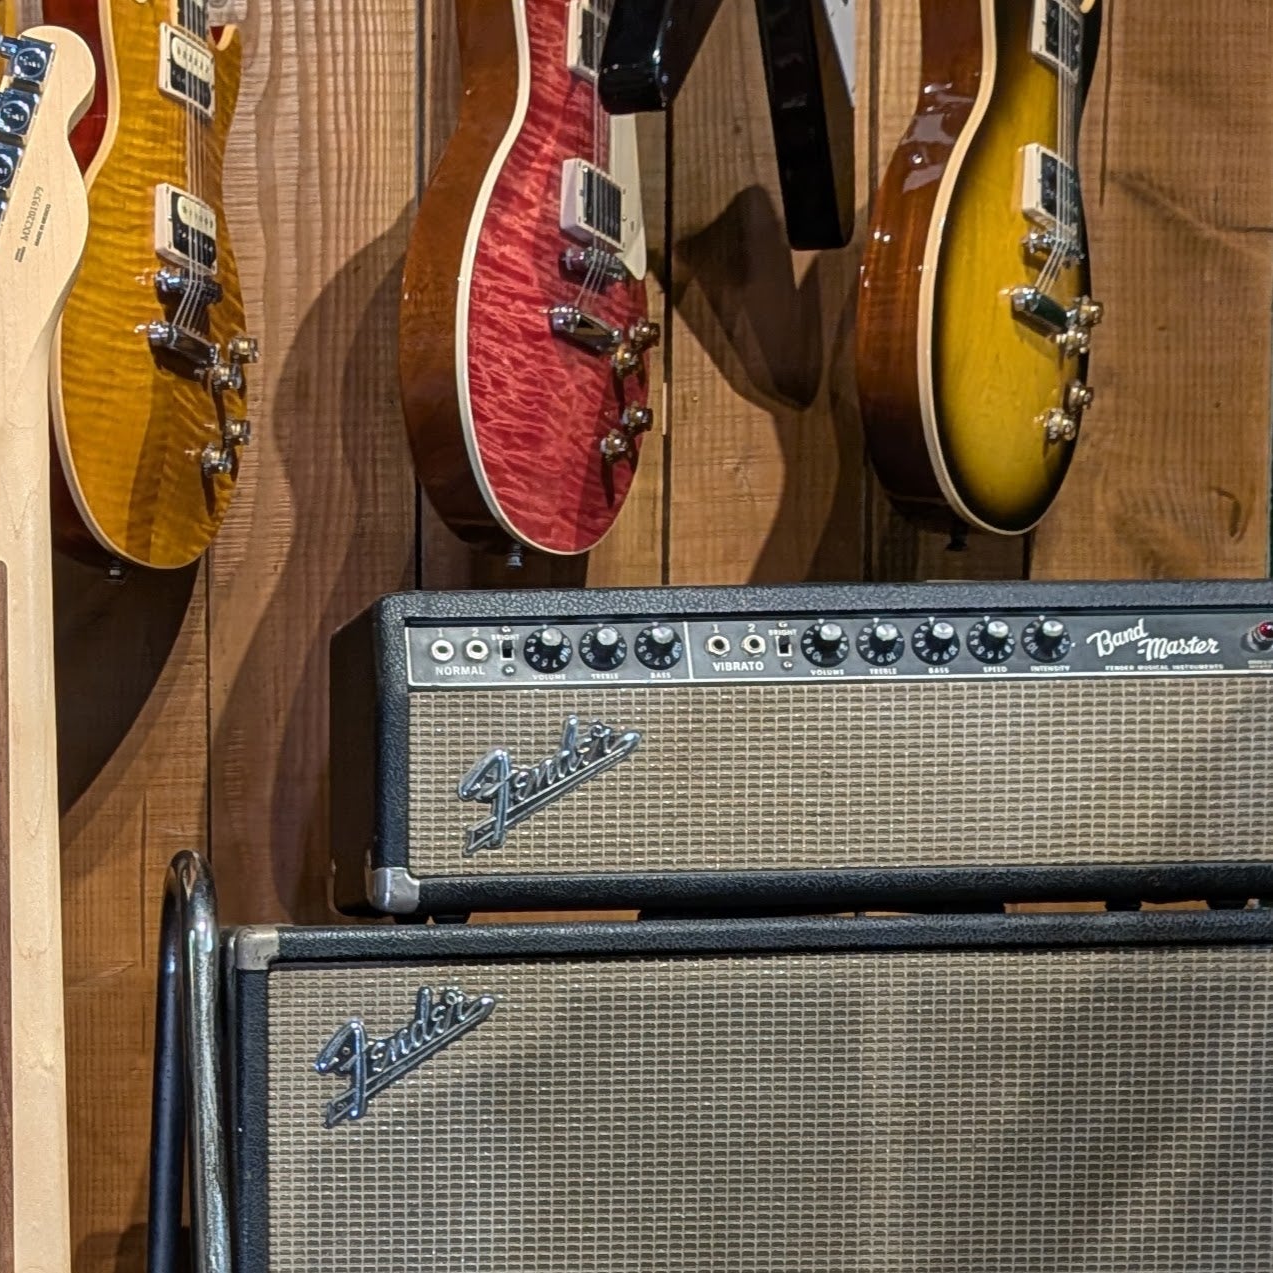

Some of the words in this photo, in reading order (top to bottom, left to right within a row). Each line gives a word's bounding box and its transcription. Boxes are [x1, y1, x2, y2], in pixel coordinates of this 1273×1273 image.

[437, 628, 444, 638] 1
[471, 628, 480, 637] 2
[712, 623, 720, 633] 1
[747, 623, 756, 633] 2
[1086, 618, 1149, 657] Band
[435, 665, 486, 676] NORMAL
[712, 661, 765, 672] VIBRATO
[458, 714, 641, 854] Fender
[314, 986, 496, 1128] Fender
